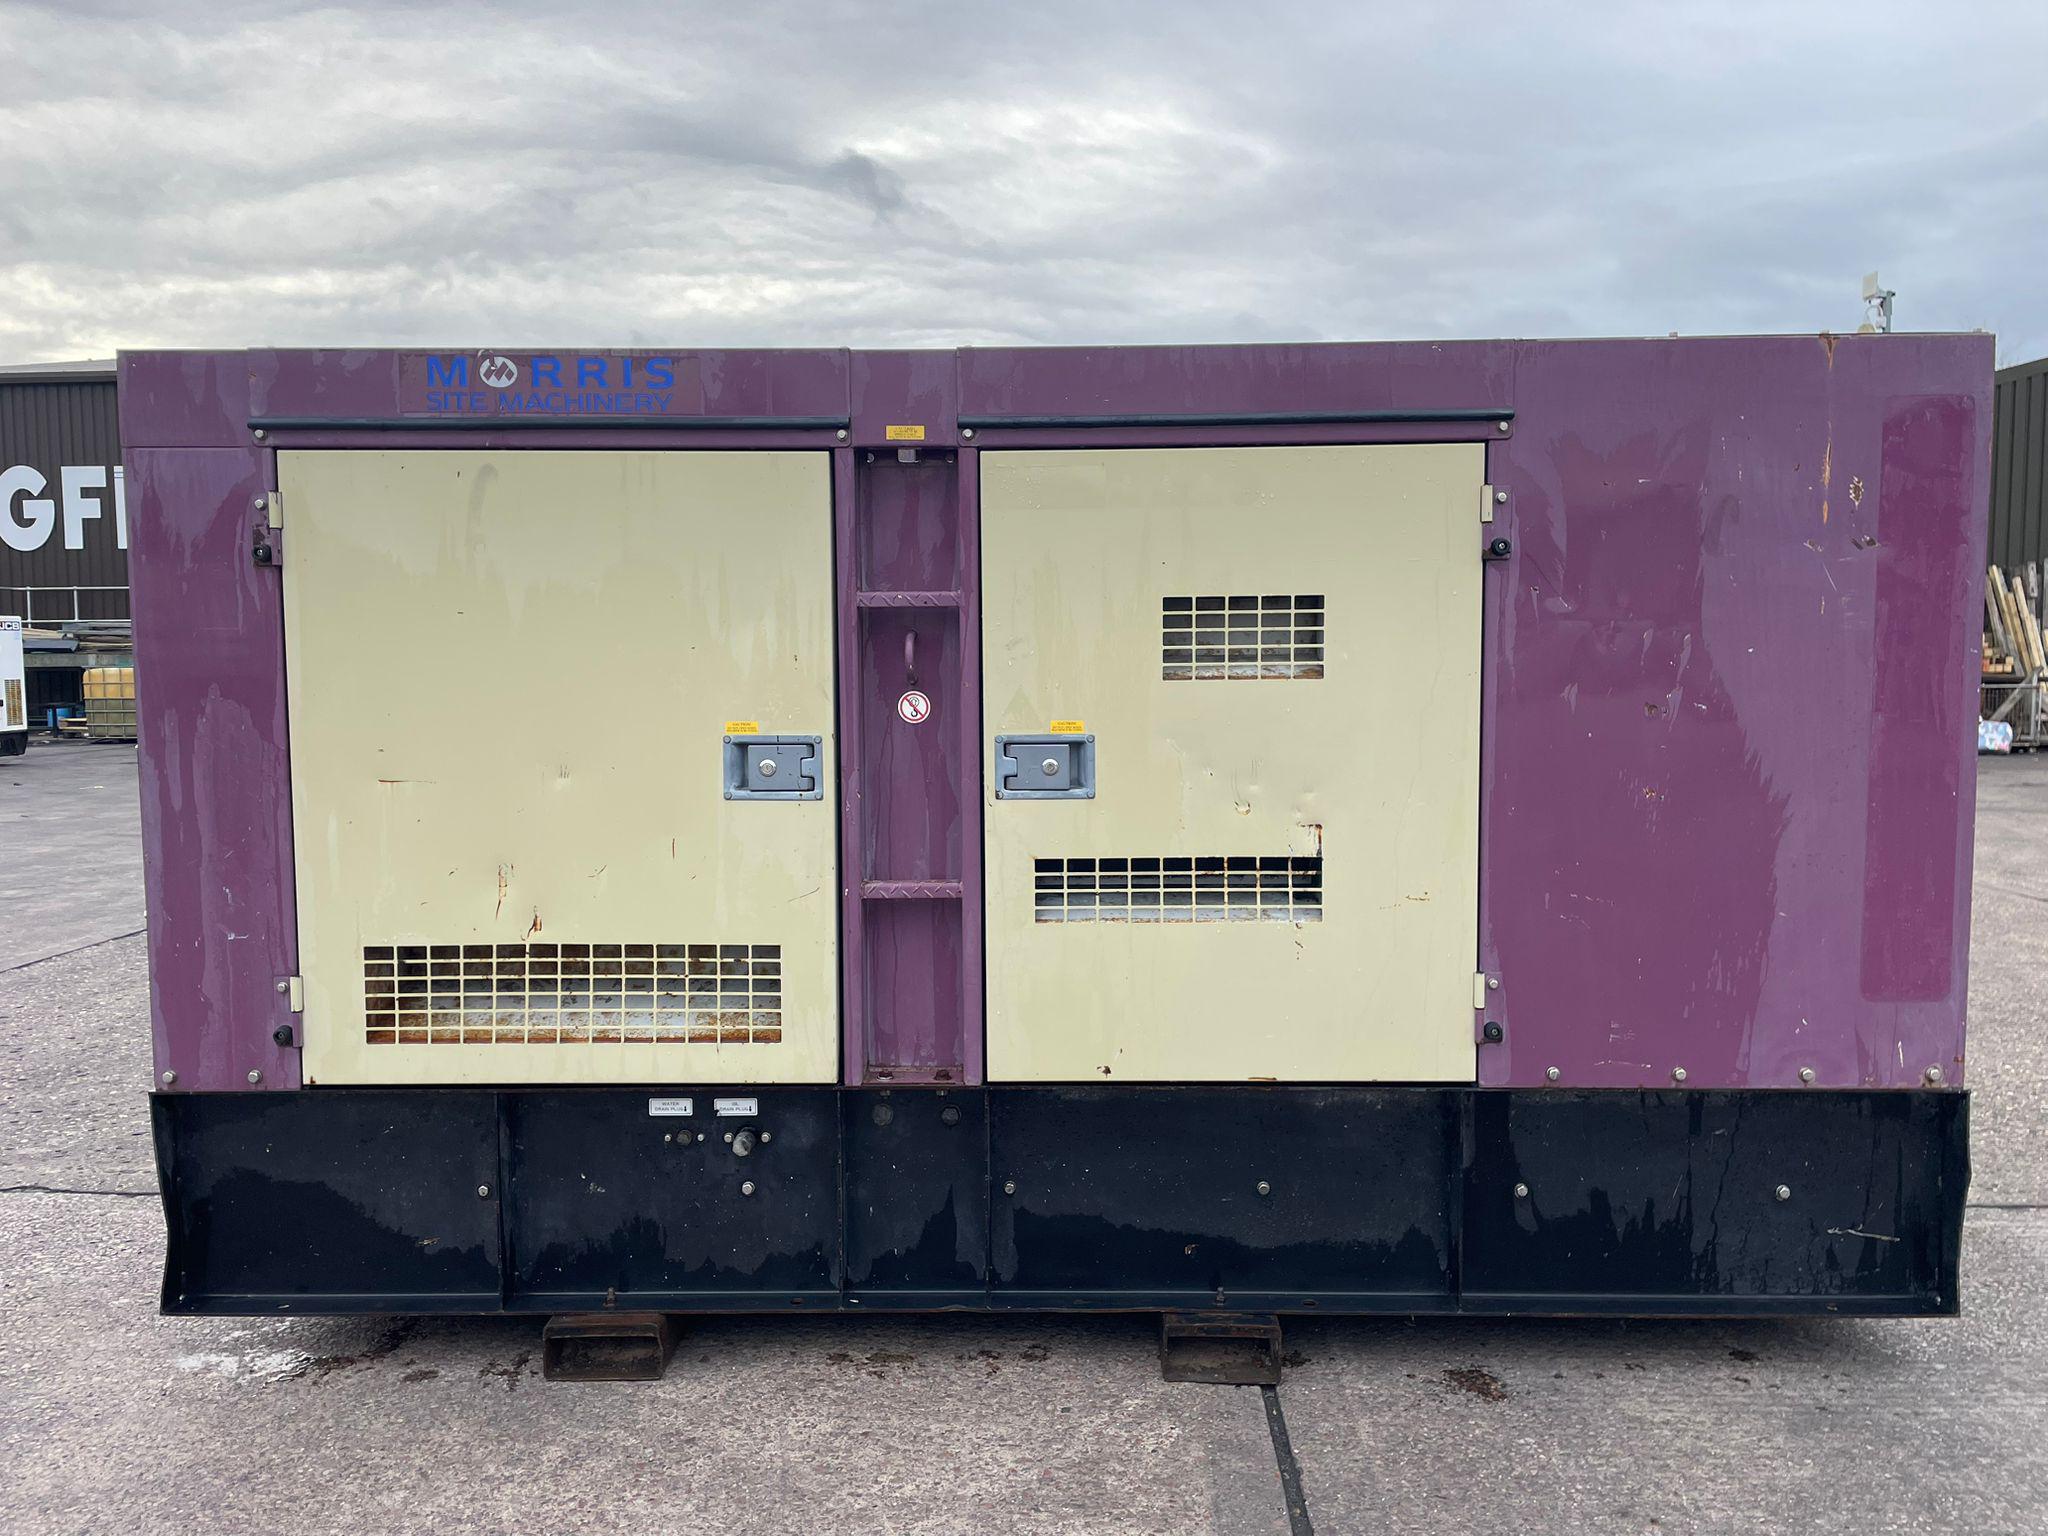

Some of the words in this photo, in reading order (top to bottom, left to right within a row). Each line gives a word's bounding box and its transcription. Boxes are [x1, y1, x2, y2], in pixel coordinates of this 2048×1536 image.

[426, 355, 676, 389] MORRIS
[426, 391, 488, 412] SITE
[499, 392, 674, 413] MACHINERY
[0, 465, 128, 552] GF
